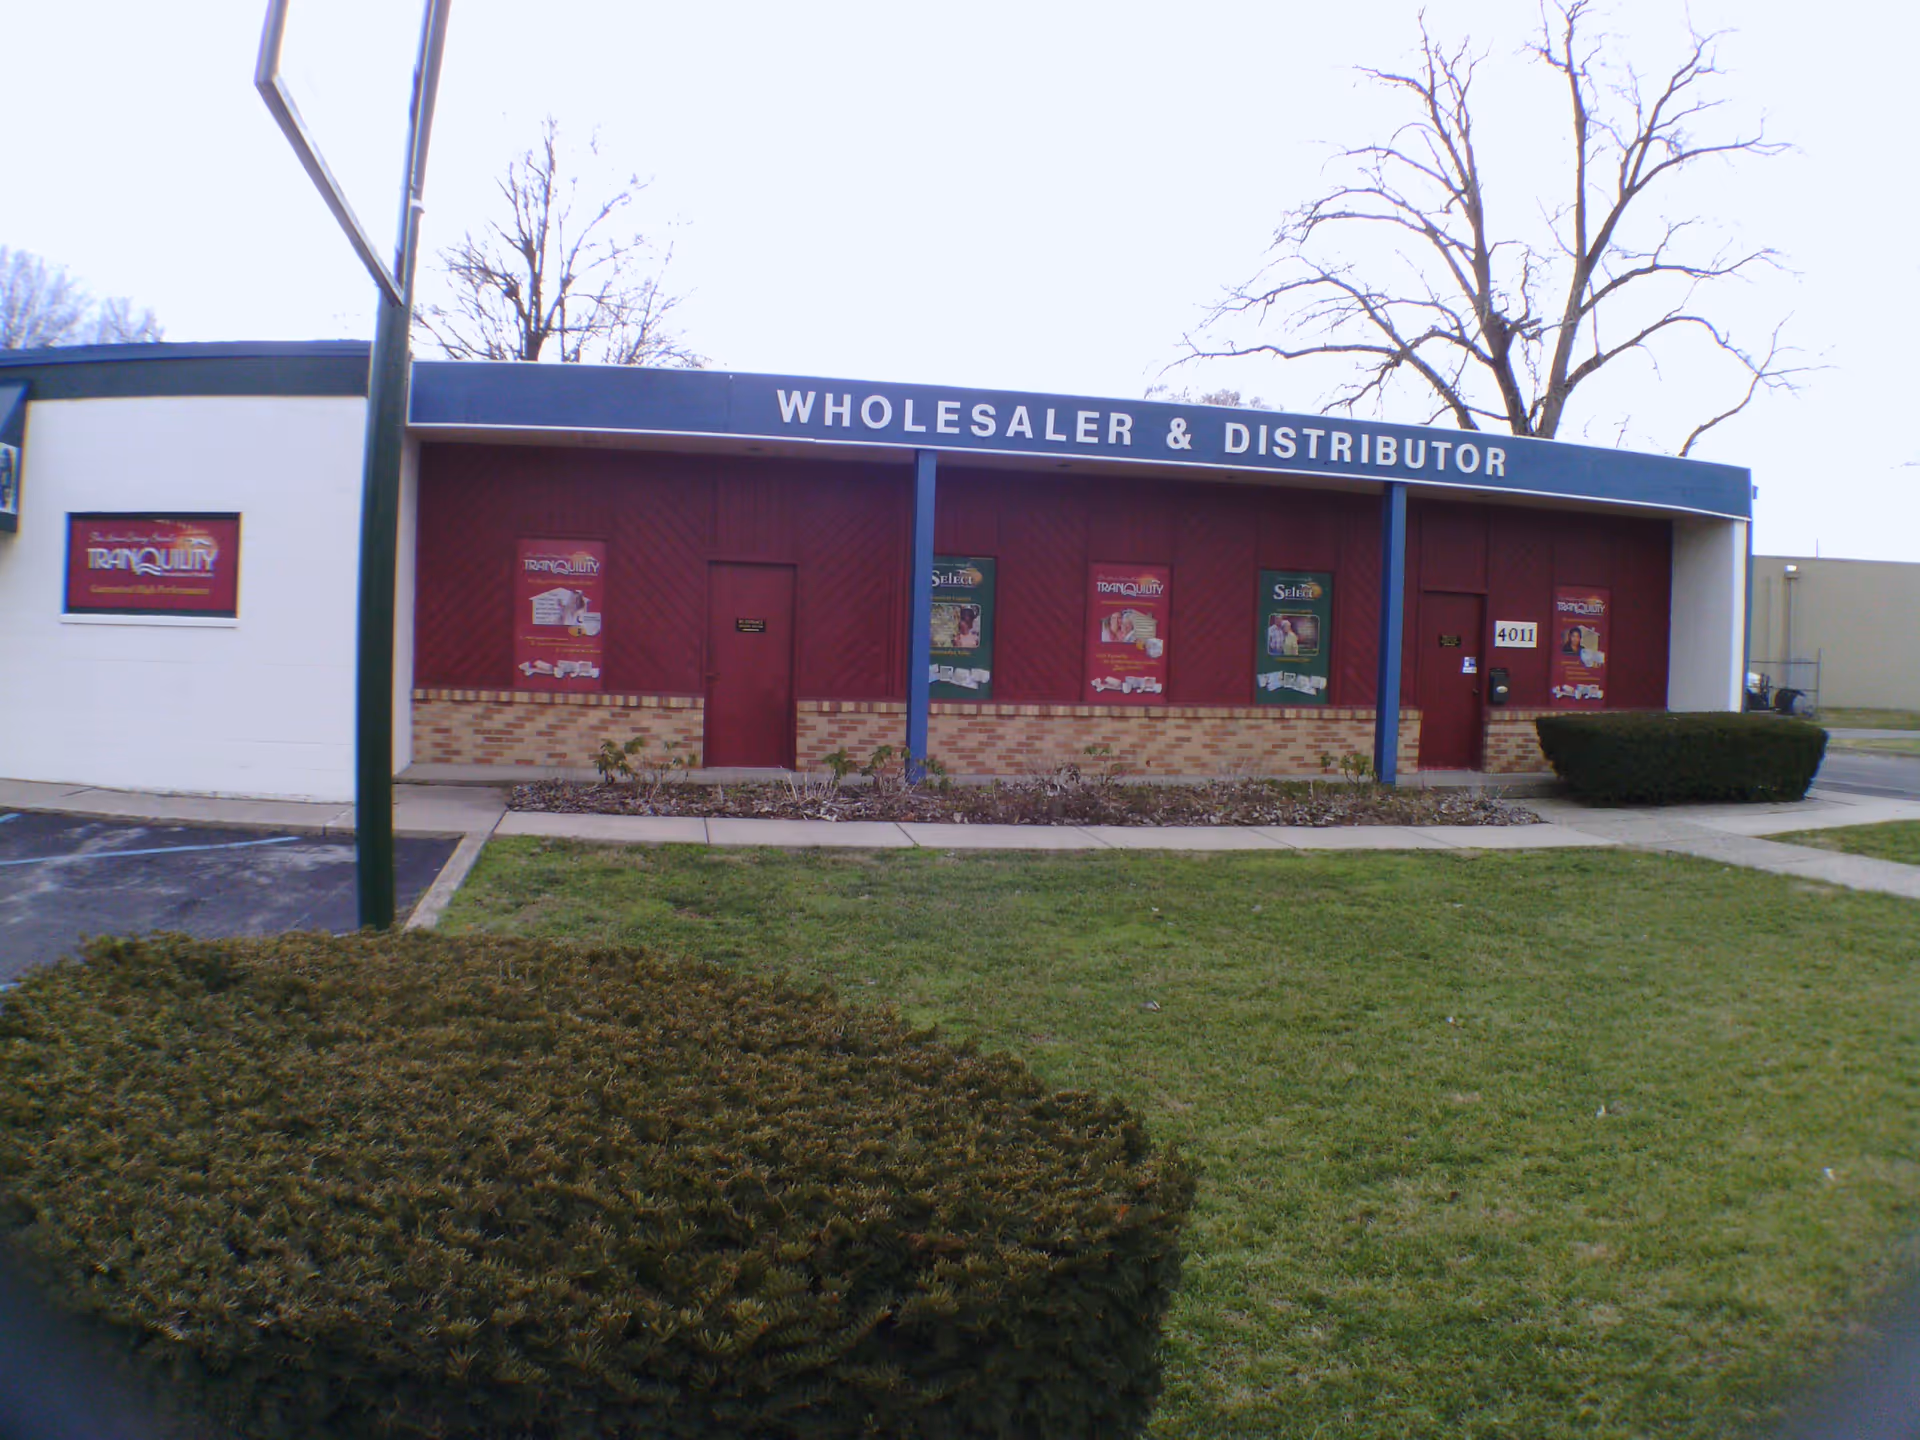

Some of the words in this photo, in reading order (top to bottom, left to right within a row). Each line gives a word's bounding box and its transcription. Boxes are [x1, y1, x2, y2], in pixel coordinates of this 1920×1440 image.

[776, 389, 1134, 446] WHOLESALER
[1165, 417, 1192, 450] &
[1224, 421, 1506, 477] DISTRIBUTOR
[86, 547, 218, 577] TRANQUILITY
[523, 559, 600, 575] TRANQUILITY
[1096, 581, 1164, 597] TRANQUILITY
[1497, 627, 1535, 643] 4011
